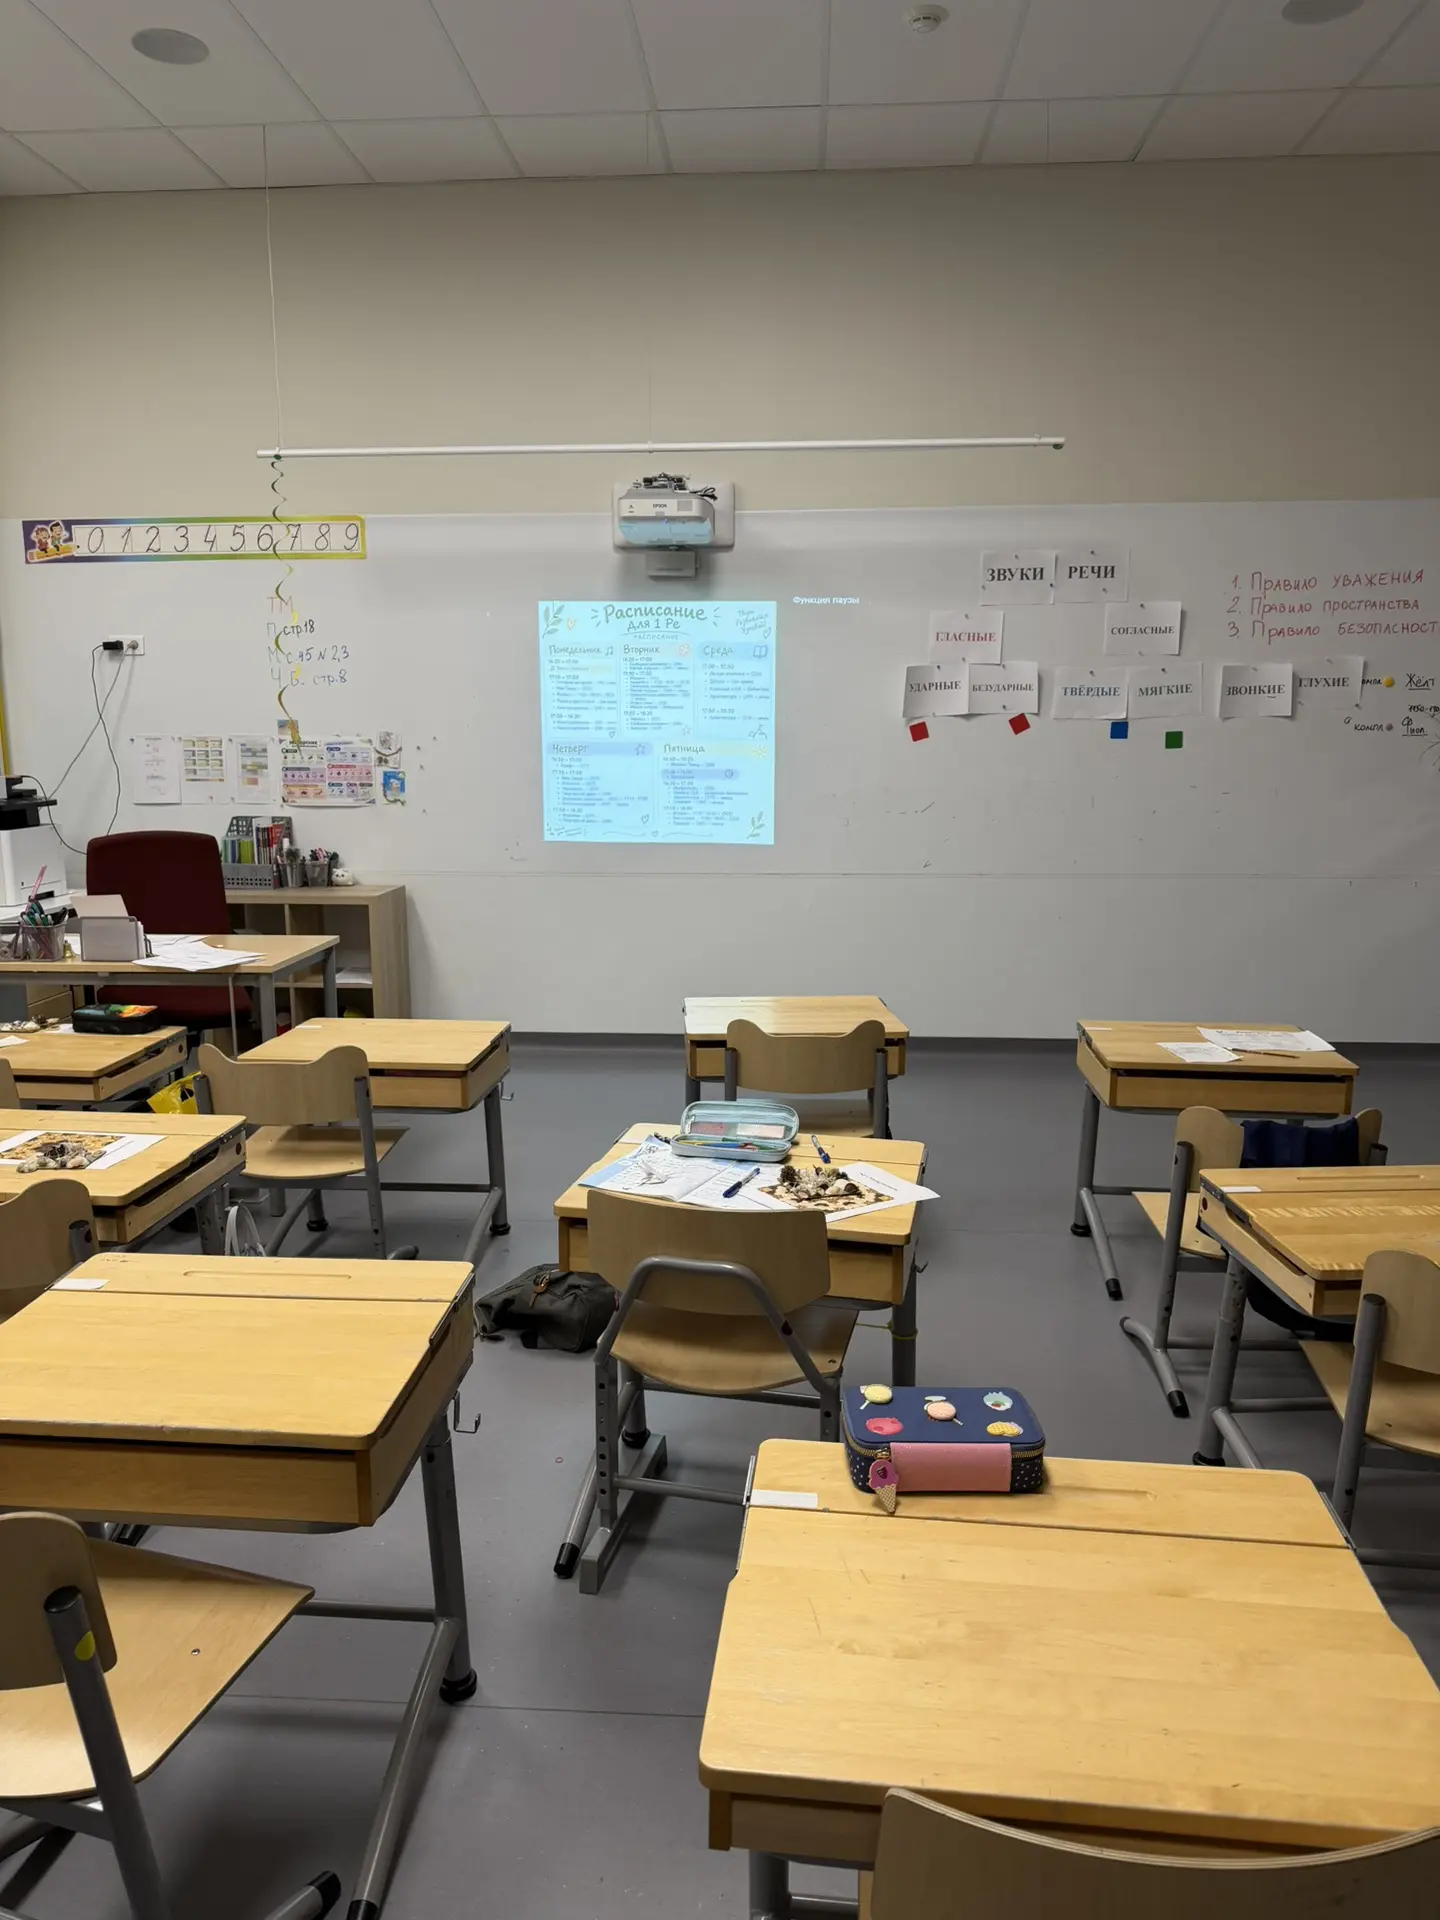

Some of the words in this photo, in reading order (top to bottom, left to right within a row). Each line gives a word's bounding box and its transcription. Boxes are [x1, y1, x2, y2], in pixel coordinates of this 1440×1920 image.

[88, 527, 104, 553] 0
[121, 527, 132, 552] 1
[145, 526, 161, 552] 2
[174, 526, 189, 553] 3
[204, 525, 217, 552] 4
[230, 525, 246, 552] 5
[257, 524, 274, 551] 6
[286, 524, 302, 552] 7
[314, 523, 331, 550] 8
[343, 523, 360, 550] 9
[986, 567, 1045, 582] ЗВУКИ
[1068, 565, 1116, 580] РЕЧИ
[793, 596, 831, 605] Функция
[833, 597, 860, 605] паузы
[603, 603, 708, 624] Расписание
[655, 618, 661, 629] 1
[1338, 621, 1440, 636] БЕЗОПАСНОСТ
[1111, 625, 1175, 635] СОГЛАСНЫЕ
[935, 631, 997, 643] ГЛАСНЫЕ
[549, 645, 602, 655] Понедельник
[623, 644, 660, 656] Вторник
[703, 645, 733, 658] Среда
[908, 680, 962, 692] УДАРНЫЕ
[972, 682, 1034, 693] БЕЗУДАРНЫЕ
[1298, 677, 1350, 688] ГЛУХИЕ
[1062, 685, 1121, 698] ТВЁРДЫЕ
[1138, 684, 1193, 697] МЯГКИЕ
[1226, 684, 1285, 696] ЗВОНКИЕ
[552, 744, 589, 755] Четверг
[663, 743, 705, 755] Пятница
